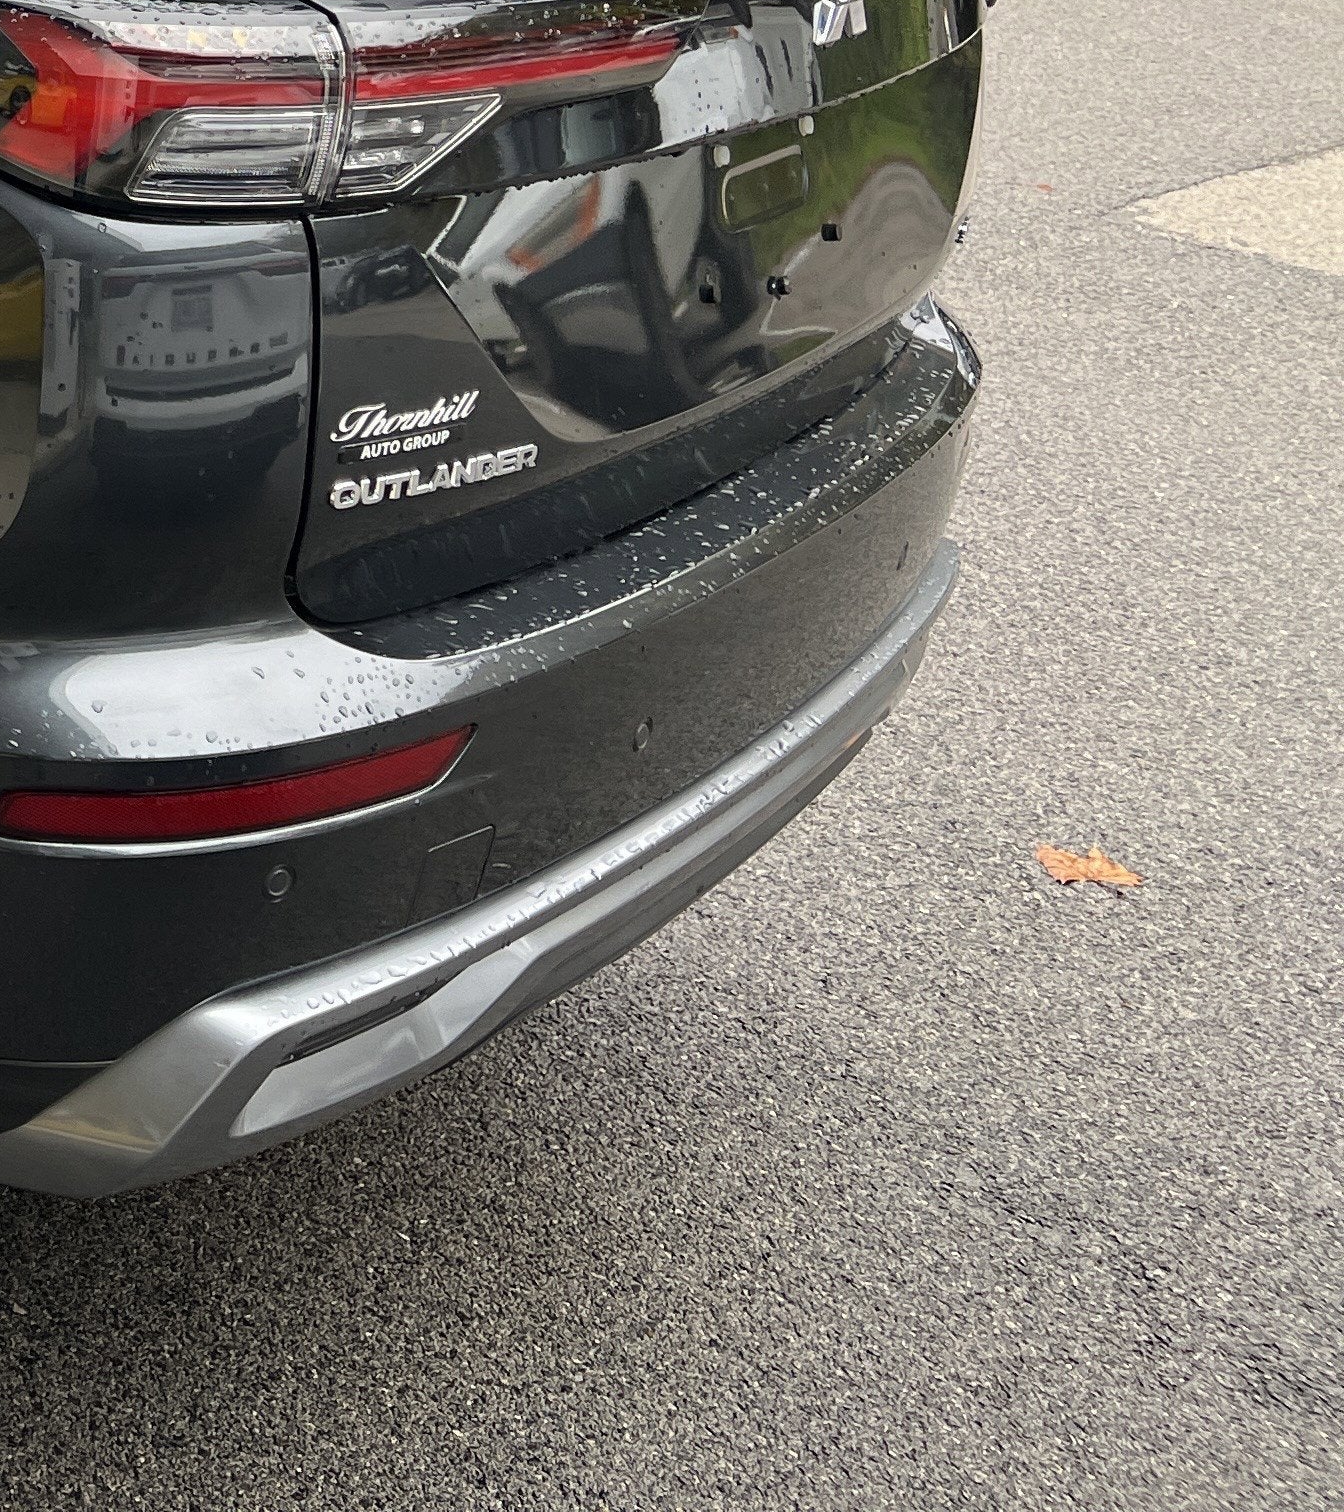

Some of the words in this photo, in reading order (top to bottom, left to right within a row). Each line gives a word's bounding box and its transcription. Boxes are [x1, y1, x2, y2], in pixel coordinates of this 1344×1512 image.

[330, 390, 480, 443] Thornhill
[359, 439, 401, 461] AUTO
[402, 428, 451, 454] GROUP
[329, 443, 539, 511] OUTLANDER
